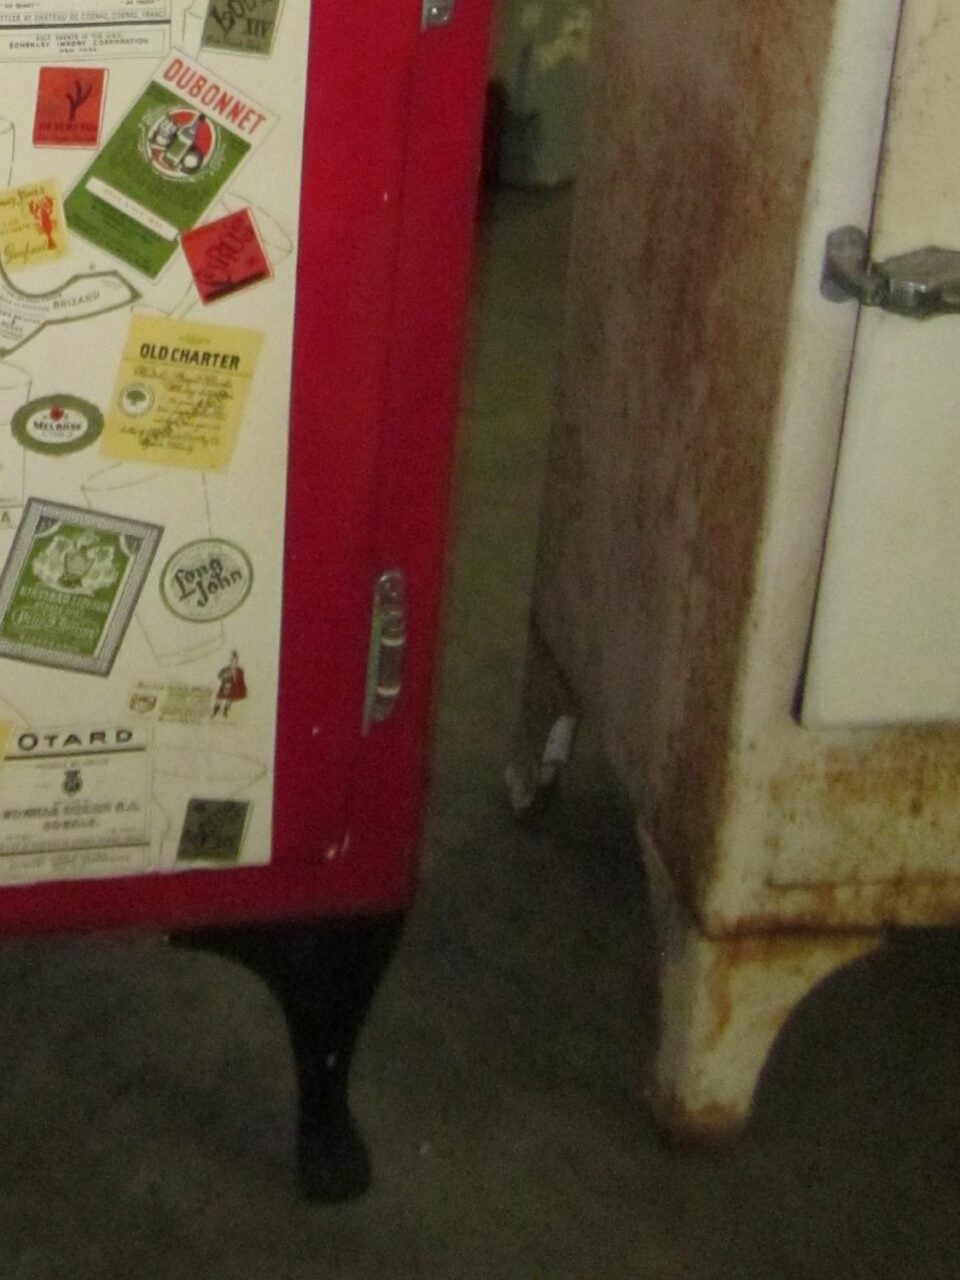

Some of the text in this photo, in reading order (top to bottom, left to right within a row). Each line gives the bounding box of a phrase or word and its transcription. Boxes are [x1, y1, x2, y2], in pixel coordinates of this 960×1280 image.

[93, 38, 149, 47] CORPORATION
[163, 58, 267, 135] DUBONNET
[52, 291, 101, 311] BRIZARD
[139, 343, 241, 371] OLD CHARTER
[174, 557, 224, 602] Long
[196, 569, 243, 608] John
[17, 729, 134, 751] OTARD
